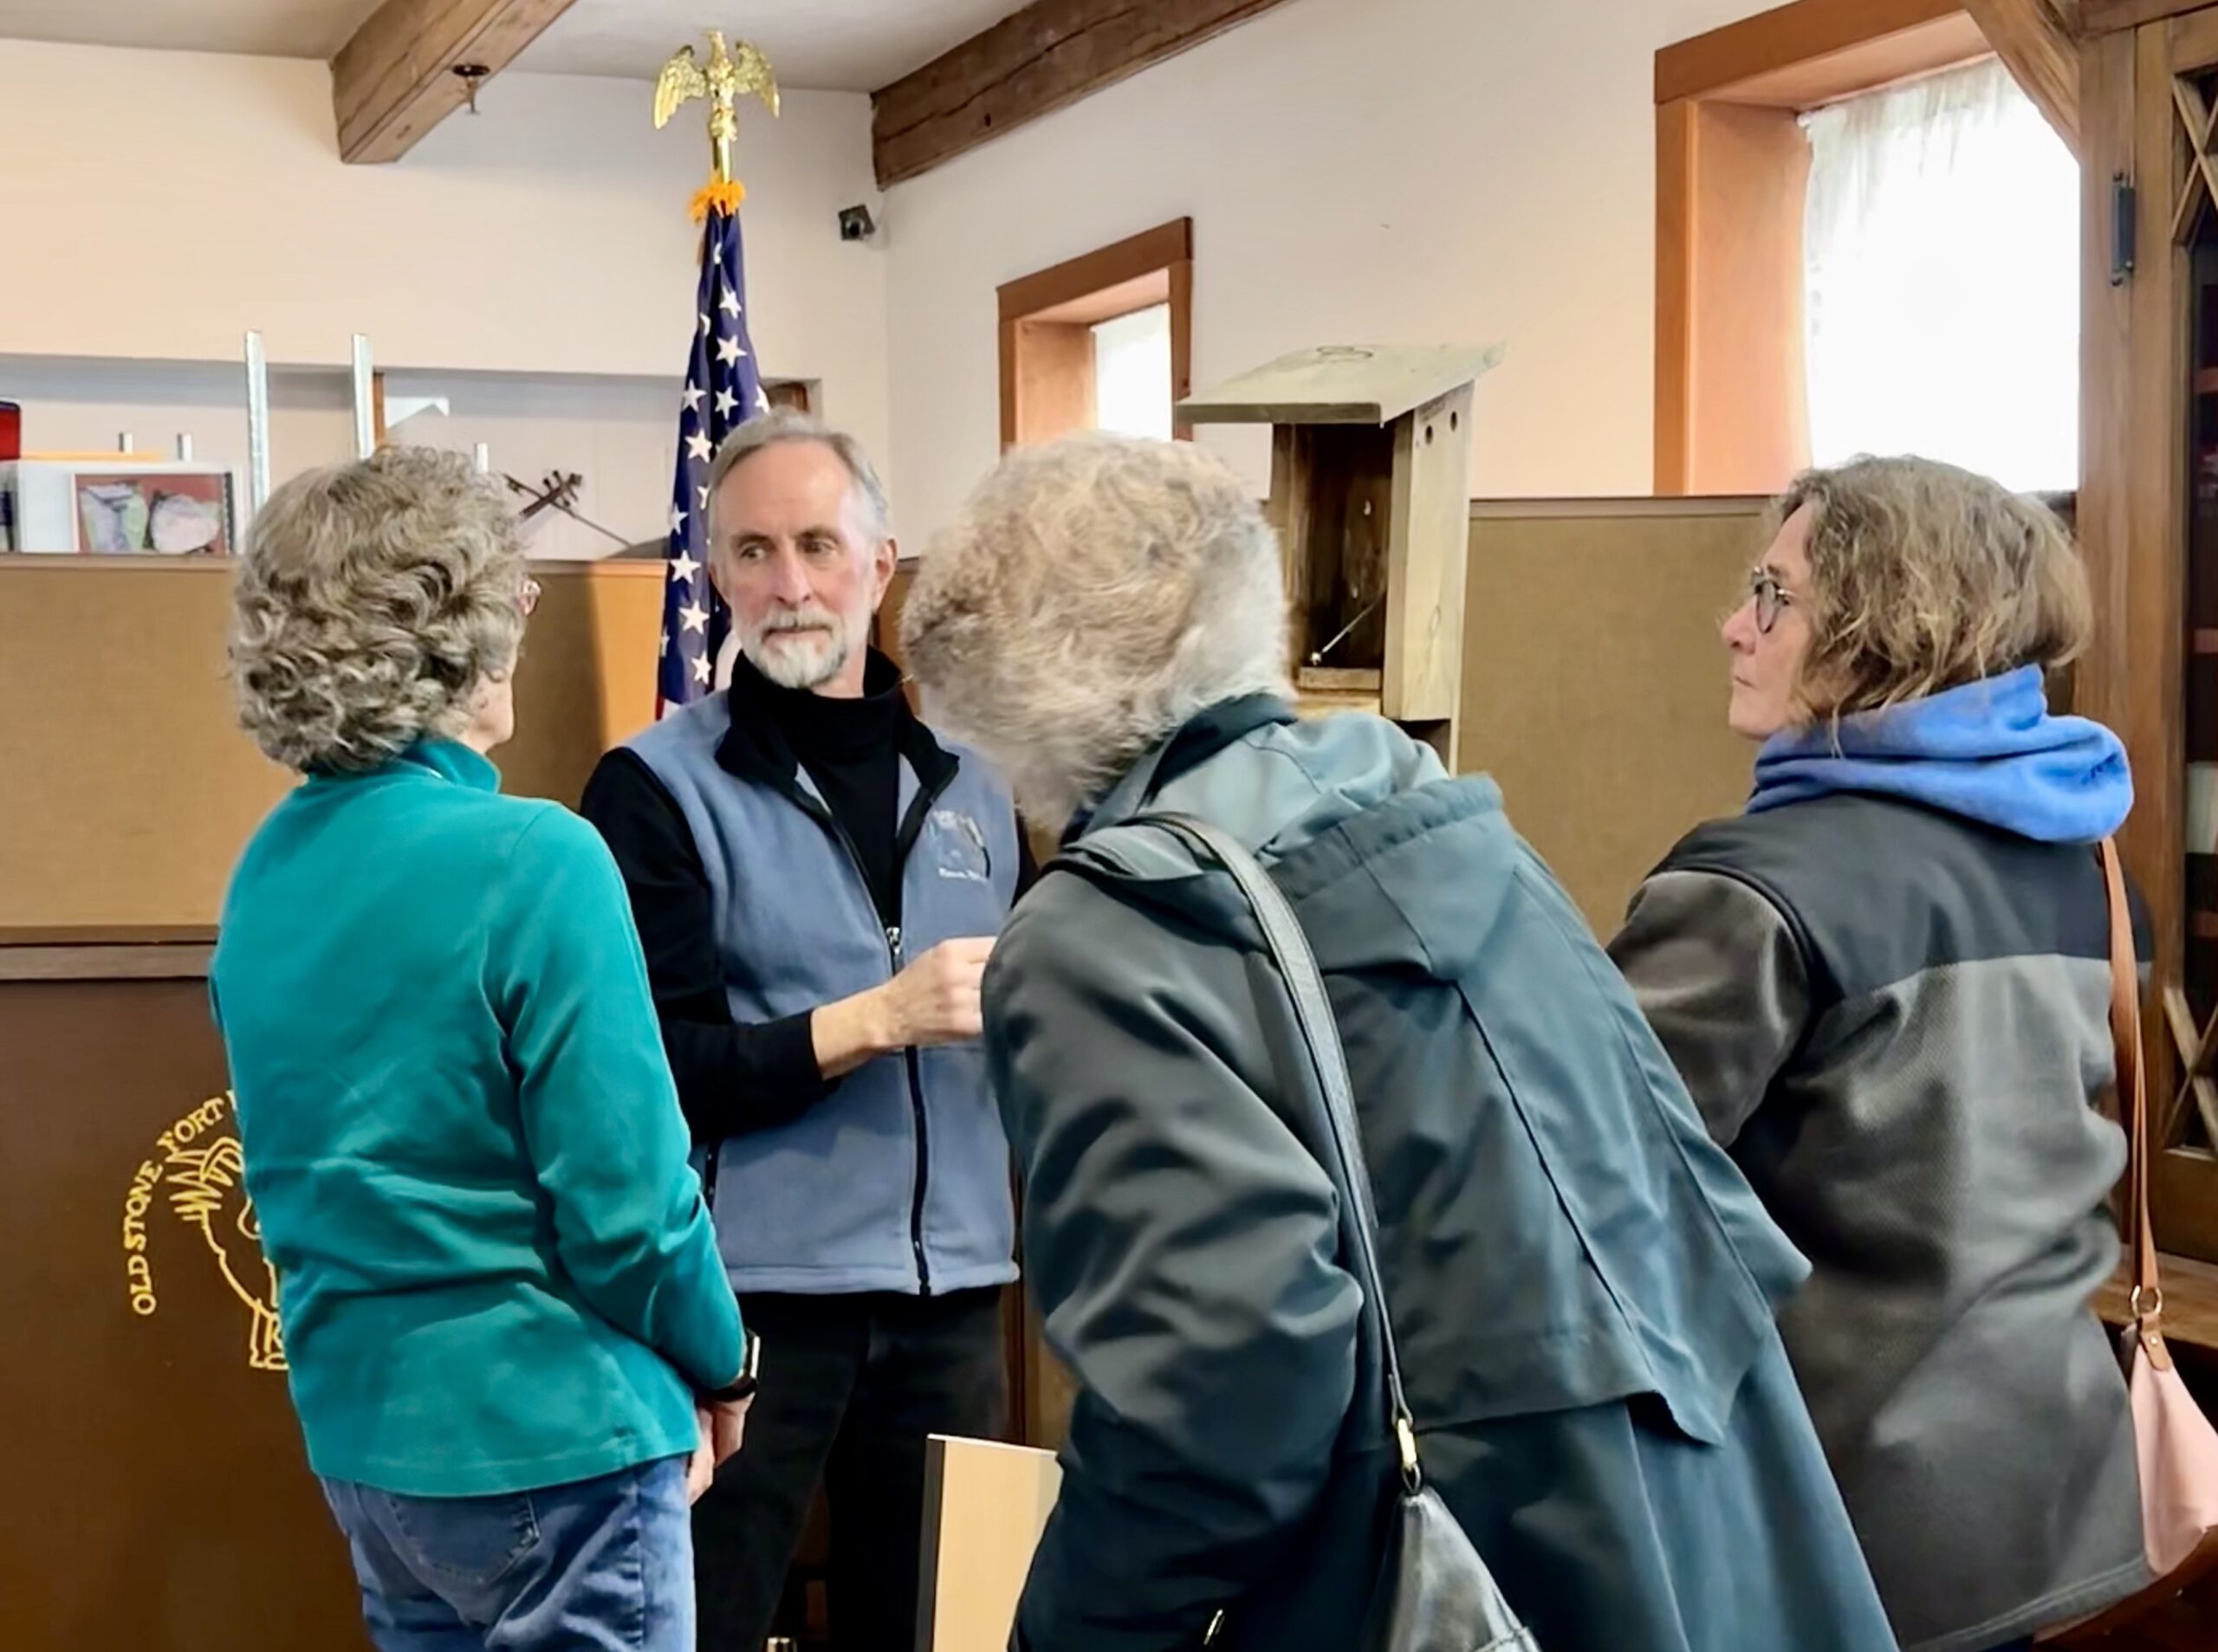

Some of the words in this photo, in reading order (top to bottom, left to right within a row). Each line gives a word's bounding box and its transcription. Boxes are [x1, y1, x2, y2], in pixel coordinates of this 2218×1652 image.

[157, 1098, 224, 1153] FORT
[124, 1160, 163, 1251] STONE
[128, 1255, 156, 1314] OLD
